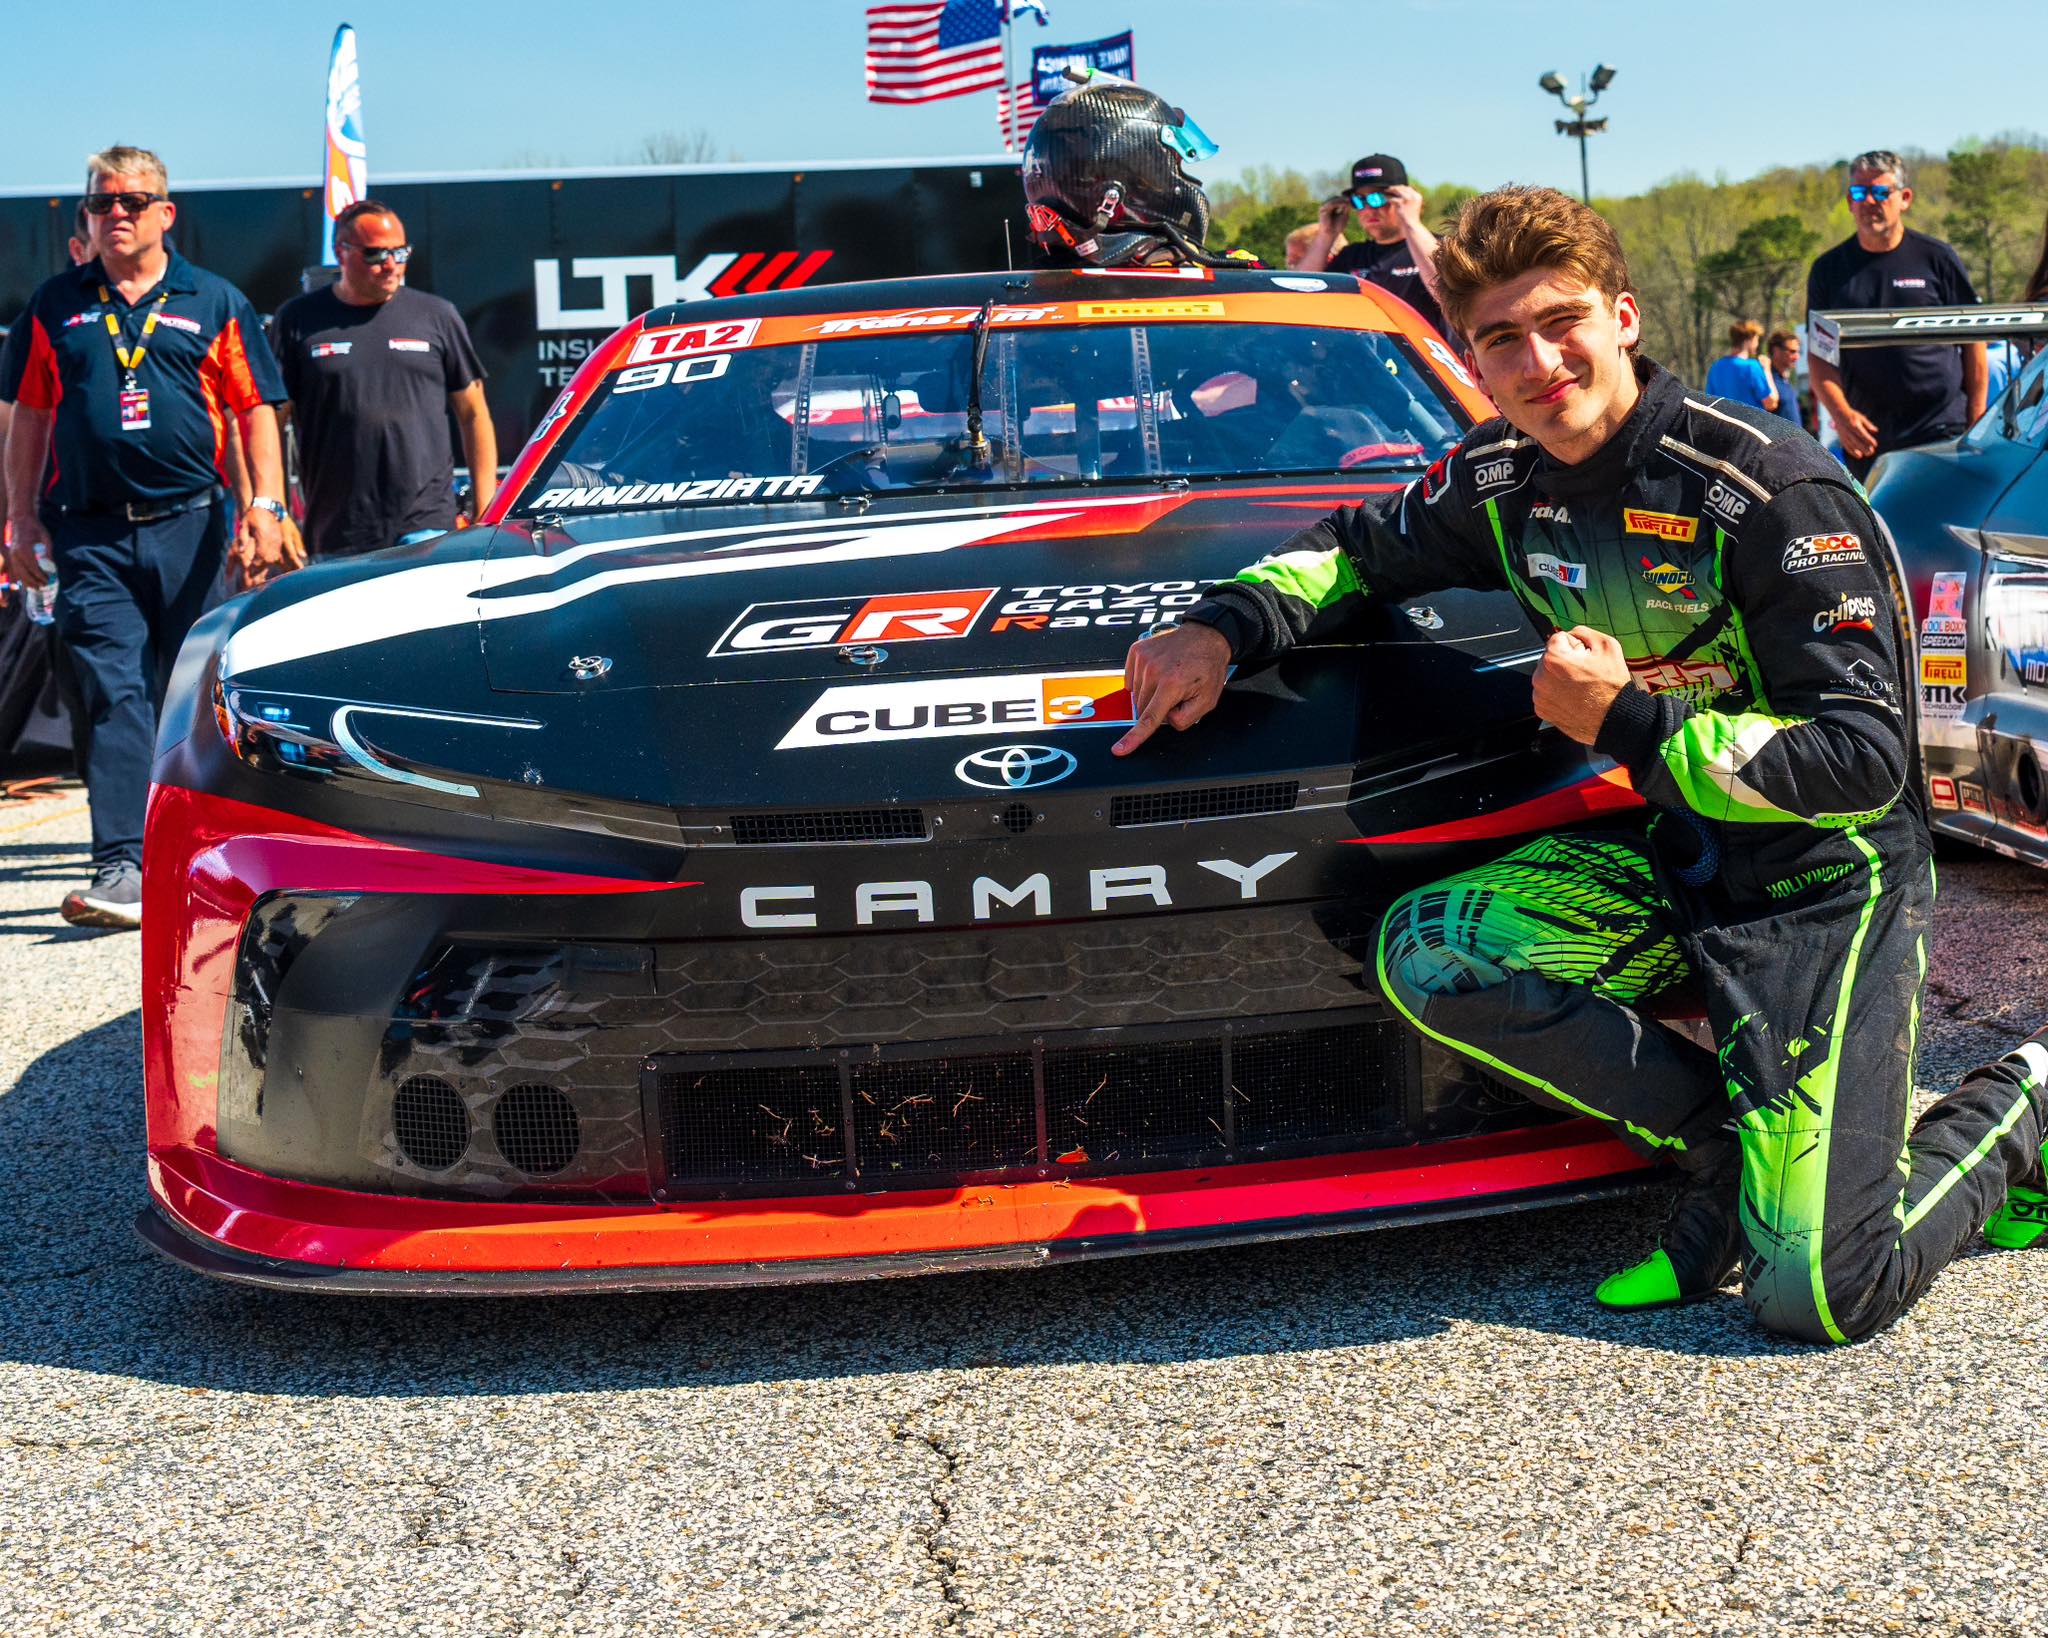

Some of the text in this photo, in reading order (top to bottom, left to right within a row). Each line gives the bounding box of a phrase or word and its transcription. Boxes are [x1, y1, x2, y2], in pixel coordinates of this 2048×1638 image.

[534, 253, 740, 330] LTK
[649, 325, 746, 356] TA2
[612, 353, 734, 394] 90
[1475, 463, 1515, 486] OMP
[529, 474, 825, 509] ANNUNZIATA
[1708, 485, 1747, 517] OMP
[1628, 512, 1692, 538] PIRELLI
[1812, 534, 1858, 552] SCC
[1787, 551, 1866, 571] PRO RACING
[1674, 602, 1710, 614] FUELS
[730, 607, 971, 649] GR
[1924, 660, 1962, 679] PIRELLI
[2026, 658, 2048, 684] MO
[740, 851, 1299, 928] CAMRY
